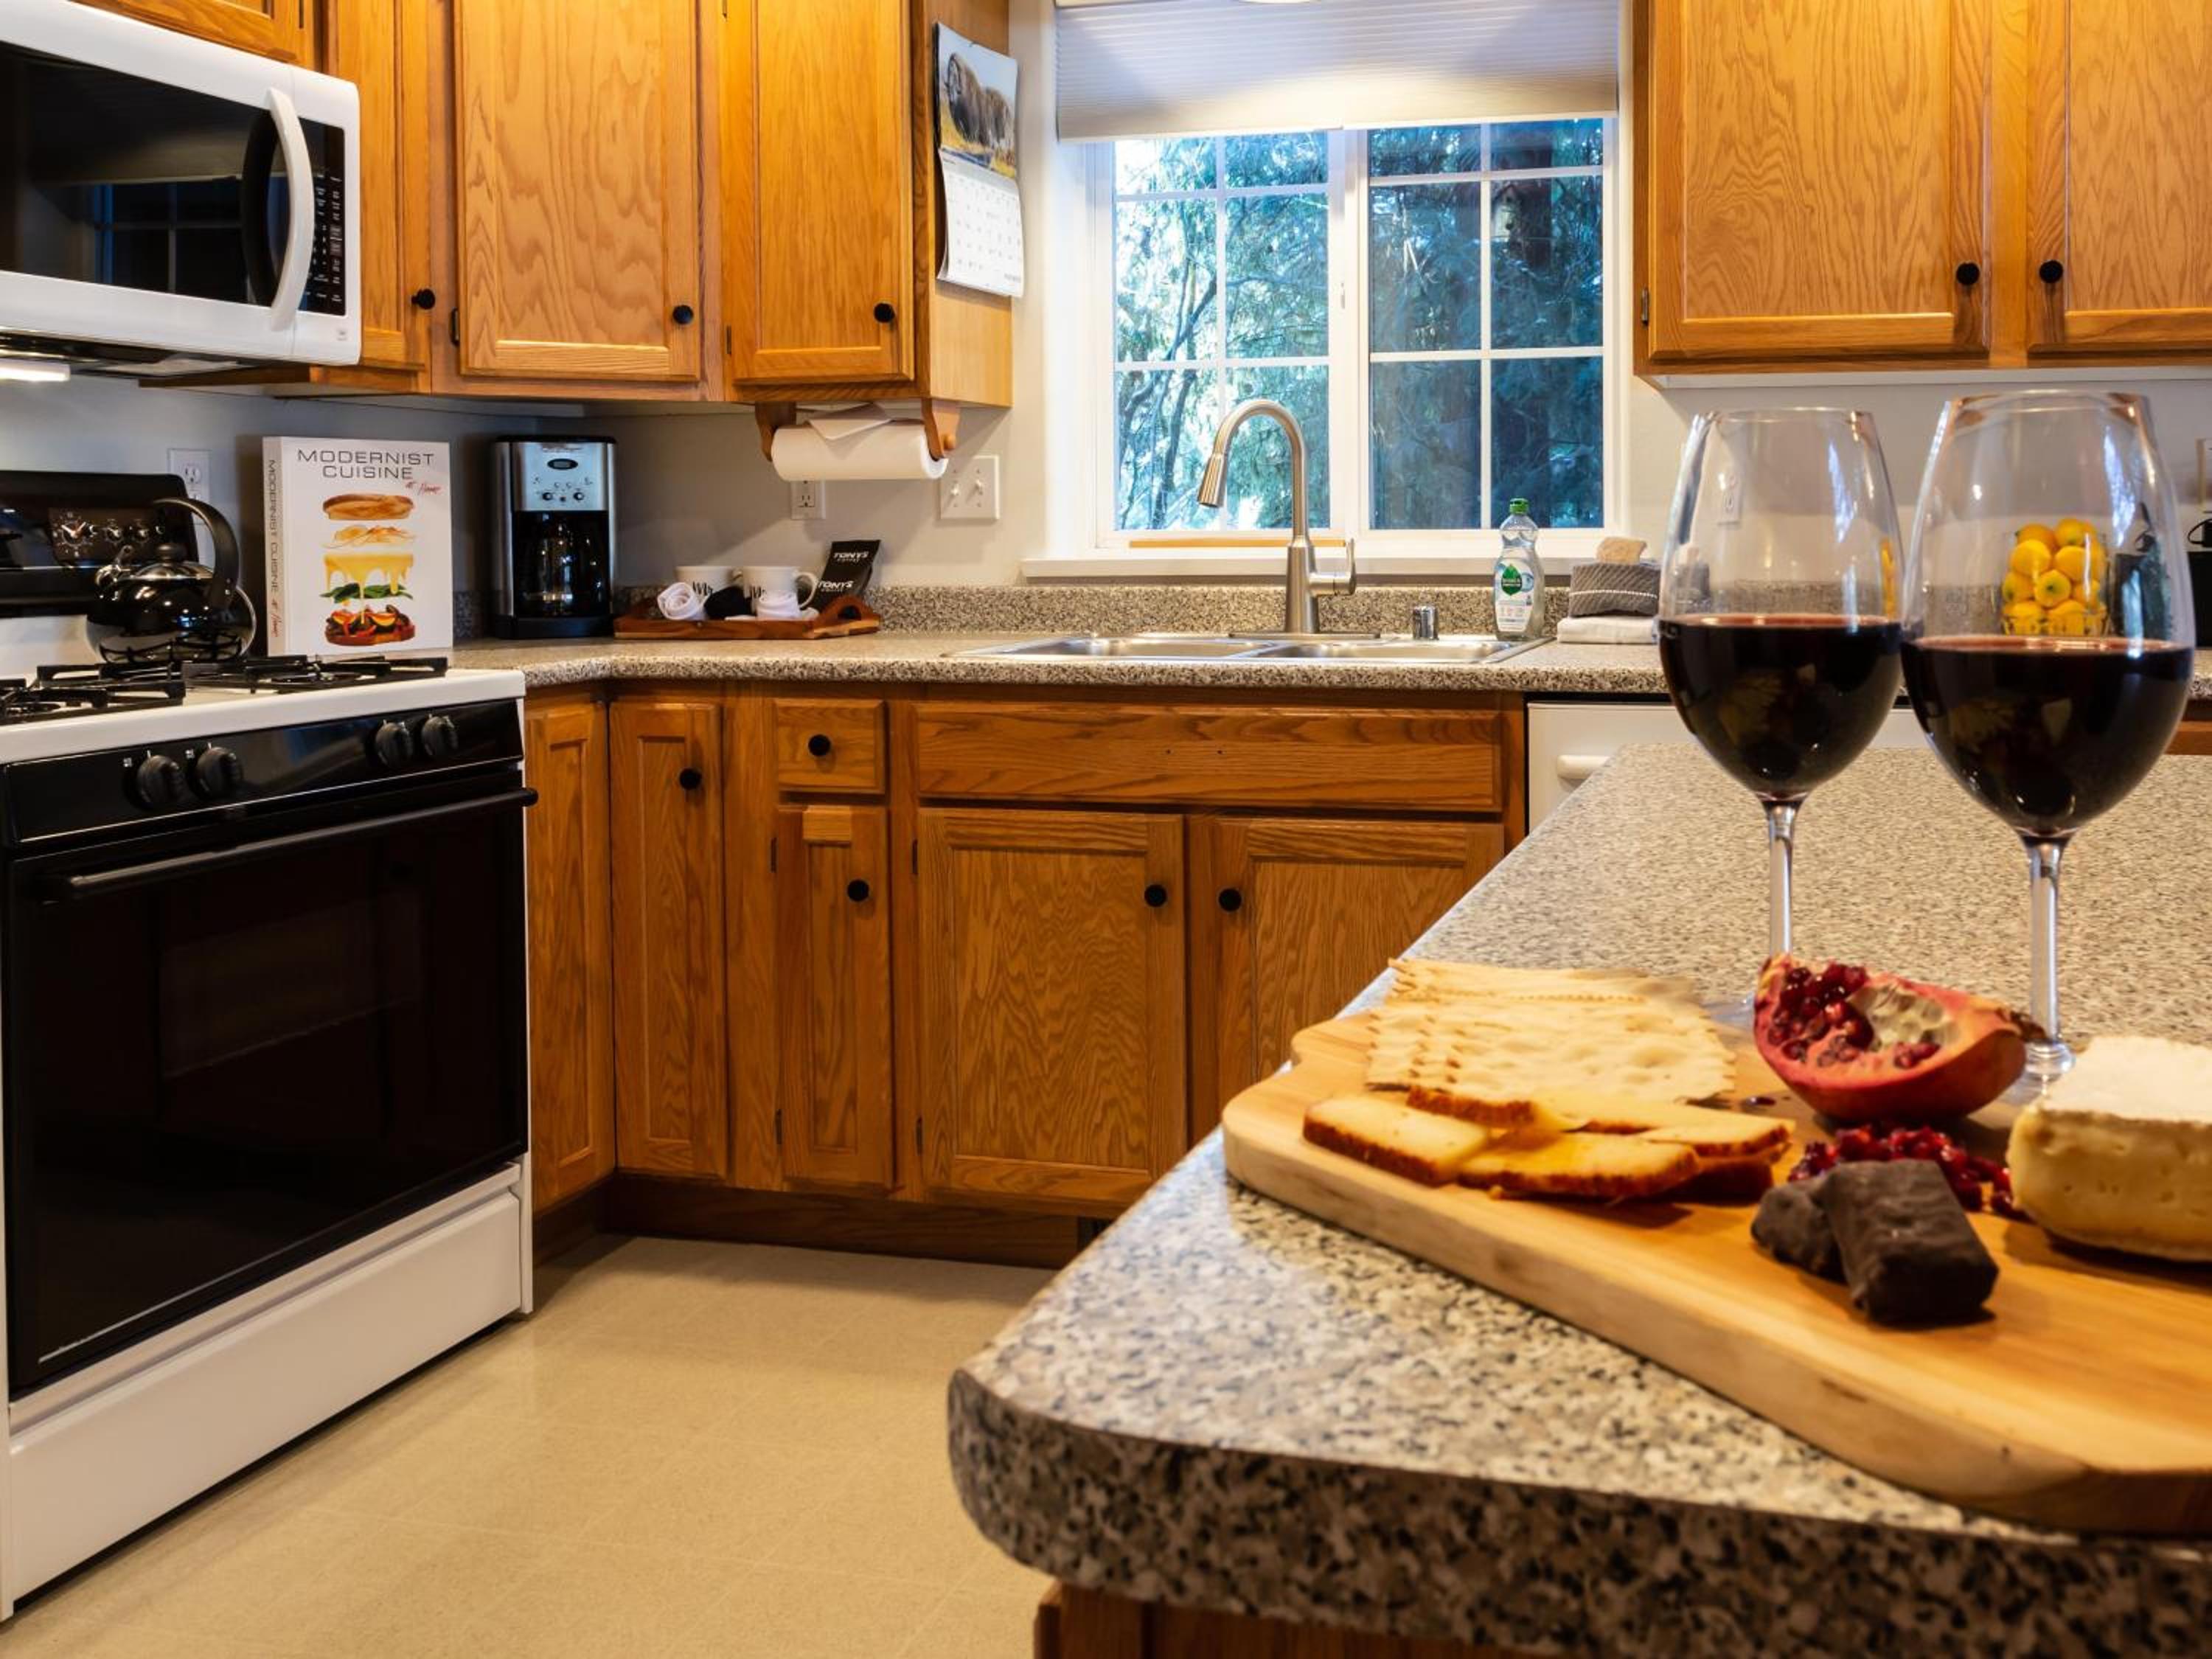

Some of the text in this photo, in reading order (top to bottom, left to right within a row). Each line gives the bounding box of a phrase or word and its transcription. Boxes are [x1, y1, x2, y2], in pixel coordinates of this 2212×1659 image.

[297, 449, 434, 465] MODERNIST
[322, 465, 414, 480] CUISINE
[268, 459, 277, 537] MODERNIST
[271, 542, 279, 592] CUISINE
